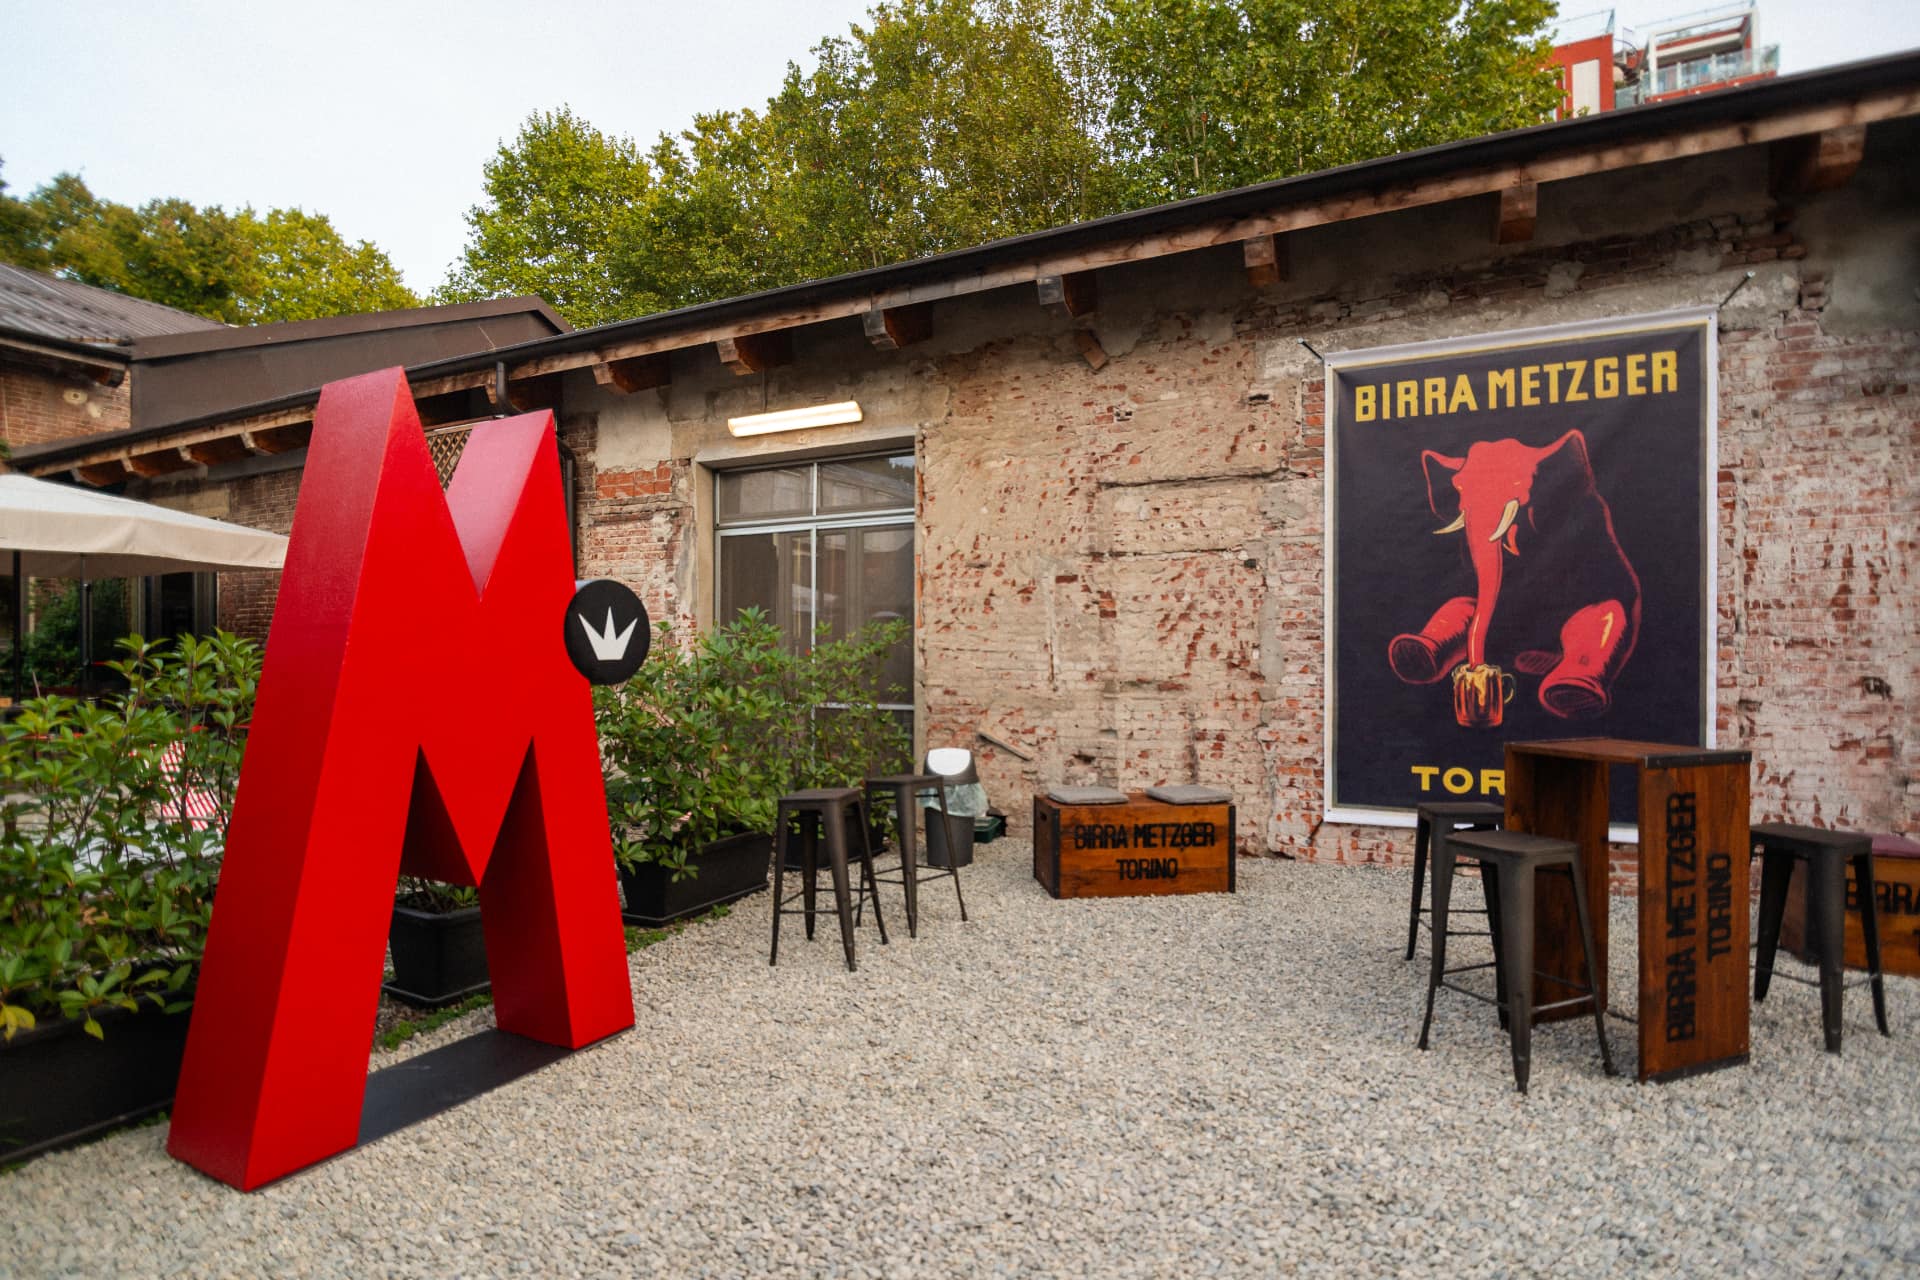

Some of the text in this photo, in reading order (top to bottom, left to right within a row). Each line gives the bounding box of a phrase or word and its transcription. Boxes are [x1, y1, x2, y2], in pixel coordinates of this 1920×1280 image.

[1355, 350, 1678, 422] BIRRA METZGER
[1411, 765, 1506, 796] TOR
[1074, 822, 1216, 850] BIRRA METZGER
[1116, 858, 1179, 881] TORINO
[1707, 852, 1732, 963] TORINO
[1844, 879, 1920, 916] BRR
[1666, 791, 1697, 1043] BIRRA METZGER
